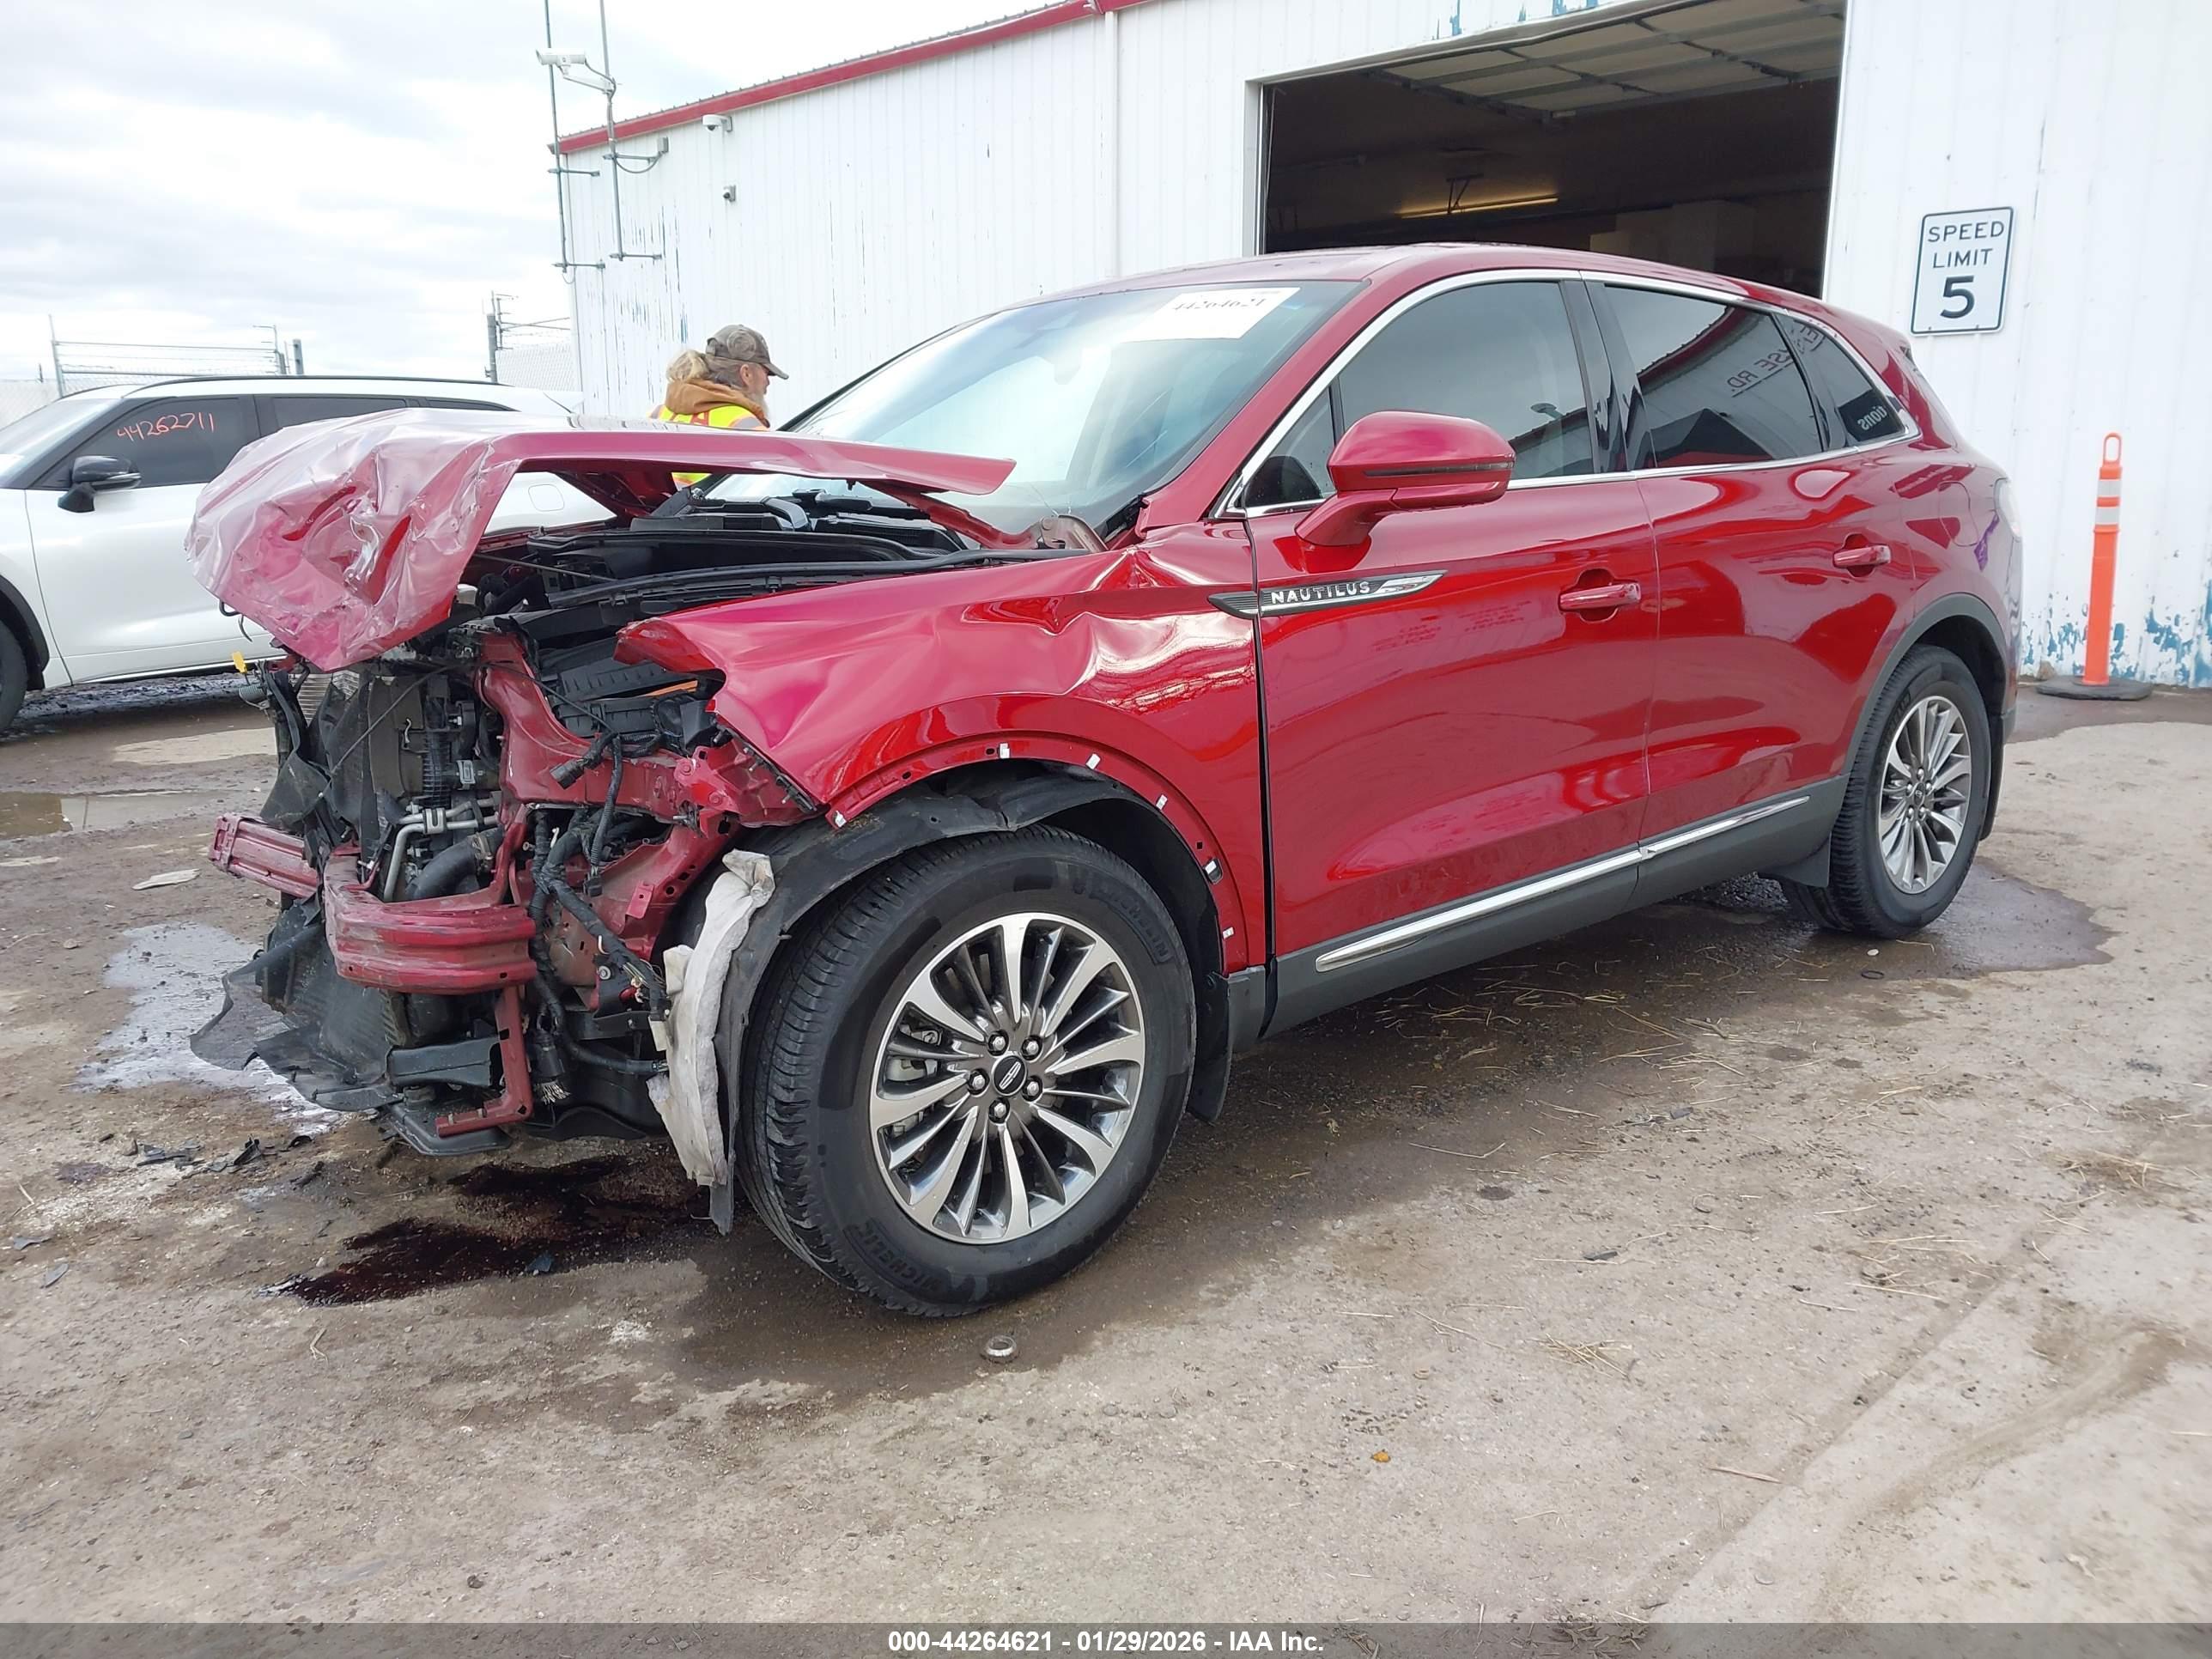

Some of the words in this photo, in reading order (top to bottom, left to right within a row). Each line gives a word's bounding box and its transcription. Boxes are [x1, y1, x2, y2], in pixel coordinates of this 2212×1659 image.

[1928, 221, 2004, 242] SPEED
[1933, 247, 1993, 268] LIMIT
[1940, 275, 1975, 319] 5
[117, 411, 215, 441] 44262711
[1271, 581, 1370, 604] NAUTILUS
